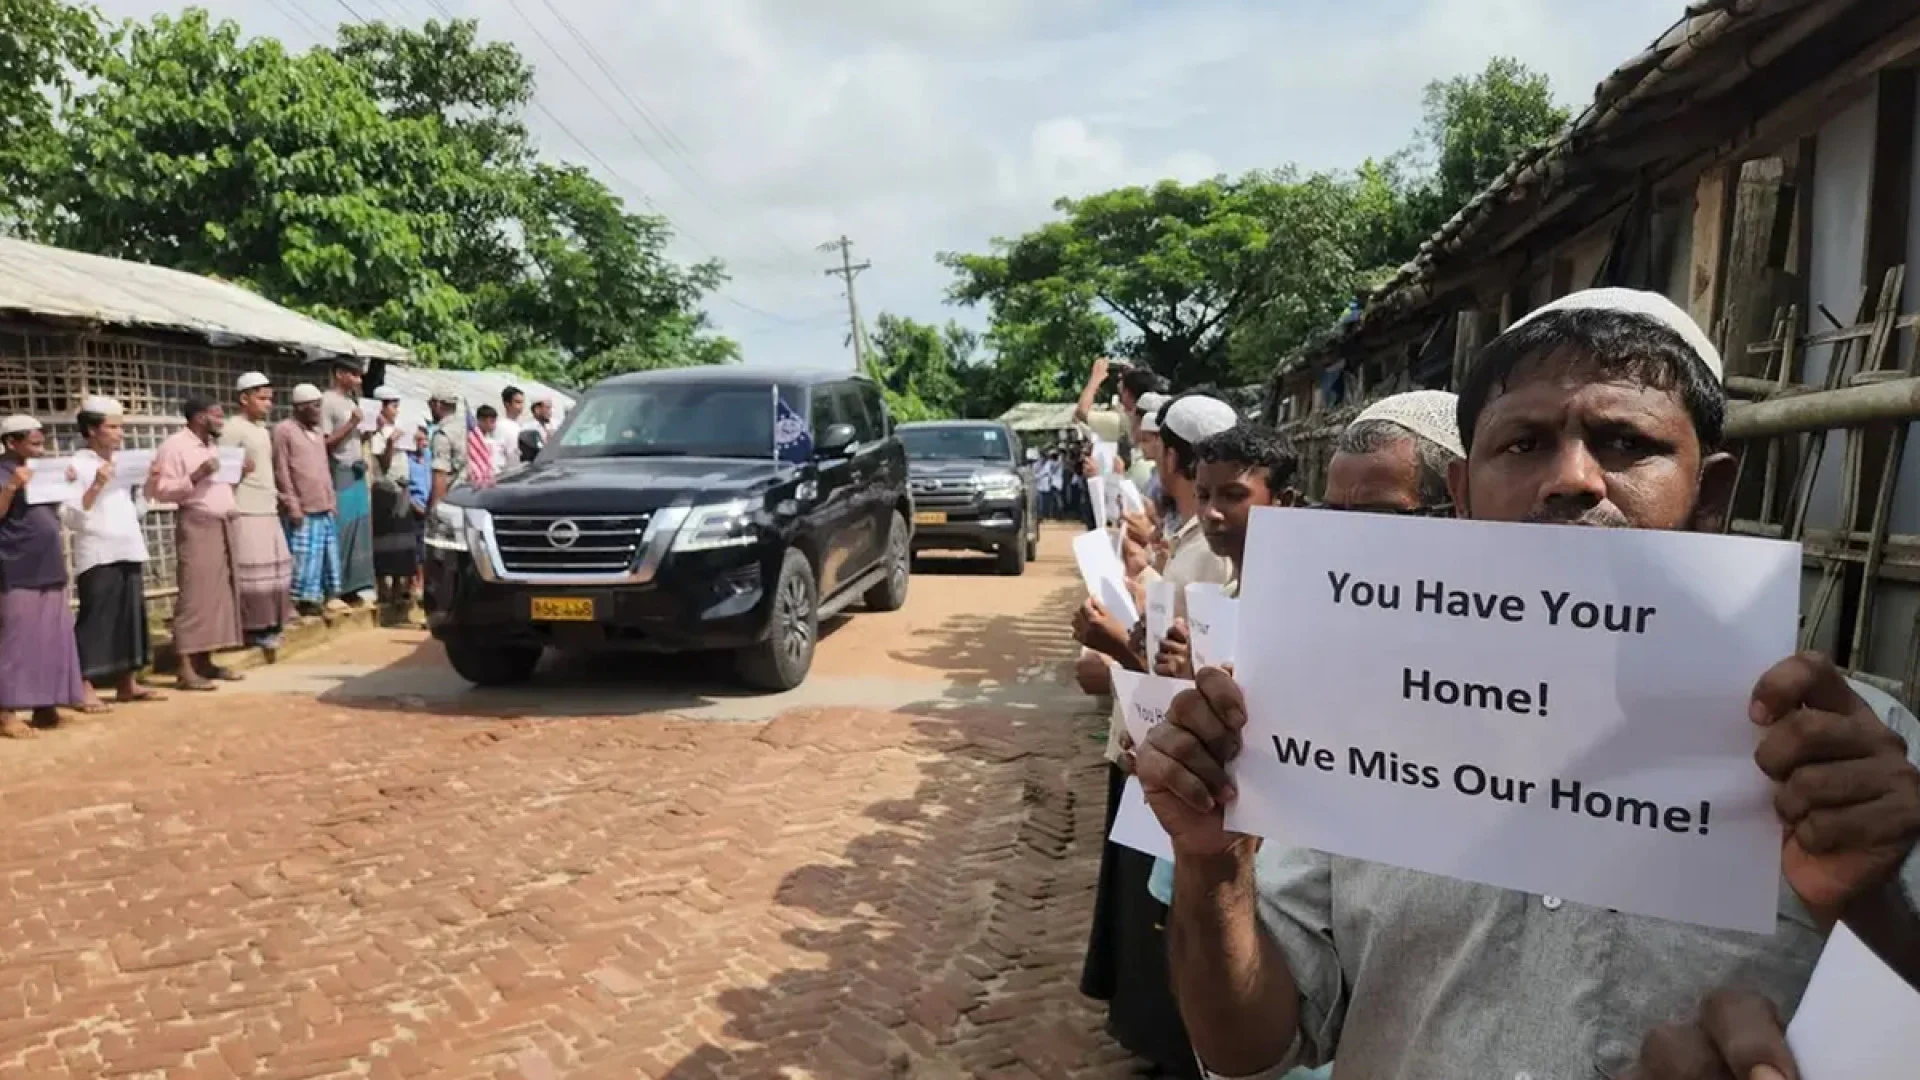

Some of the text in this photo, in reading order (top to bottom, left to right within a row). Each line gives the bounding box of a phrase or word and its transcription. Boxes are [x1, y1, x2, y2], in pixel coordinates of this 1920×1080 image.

[1327, 570, 1657, 635] You Have Your
[1402, 667, 1548, 718] Home!
[1271, 735, 1711, 836] We Miss Our Home!
